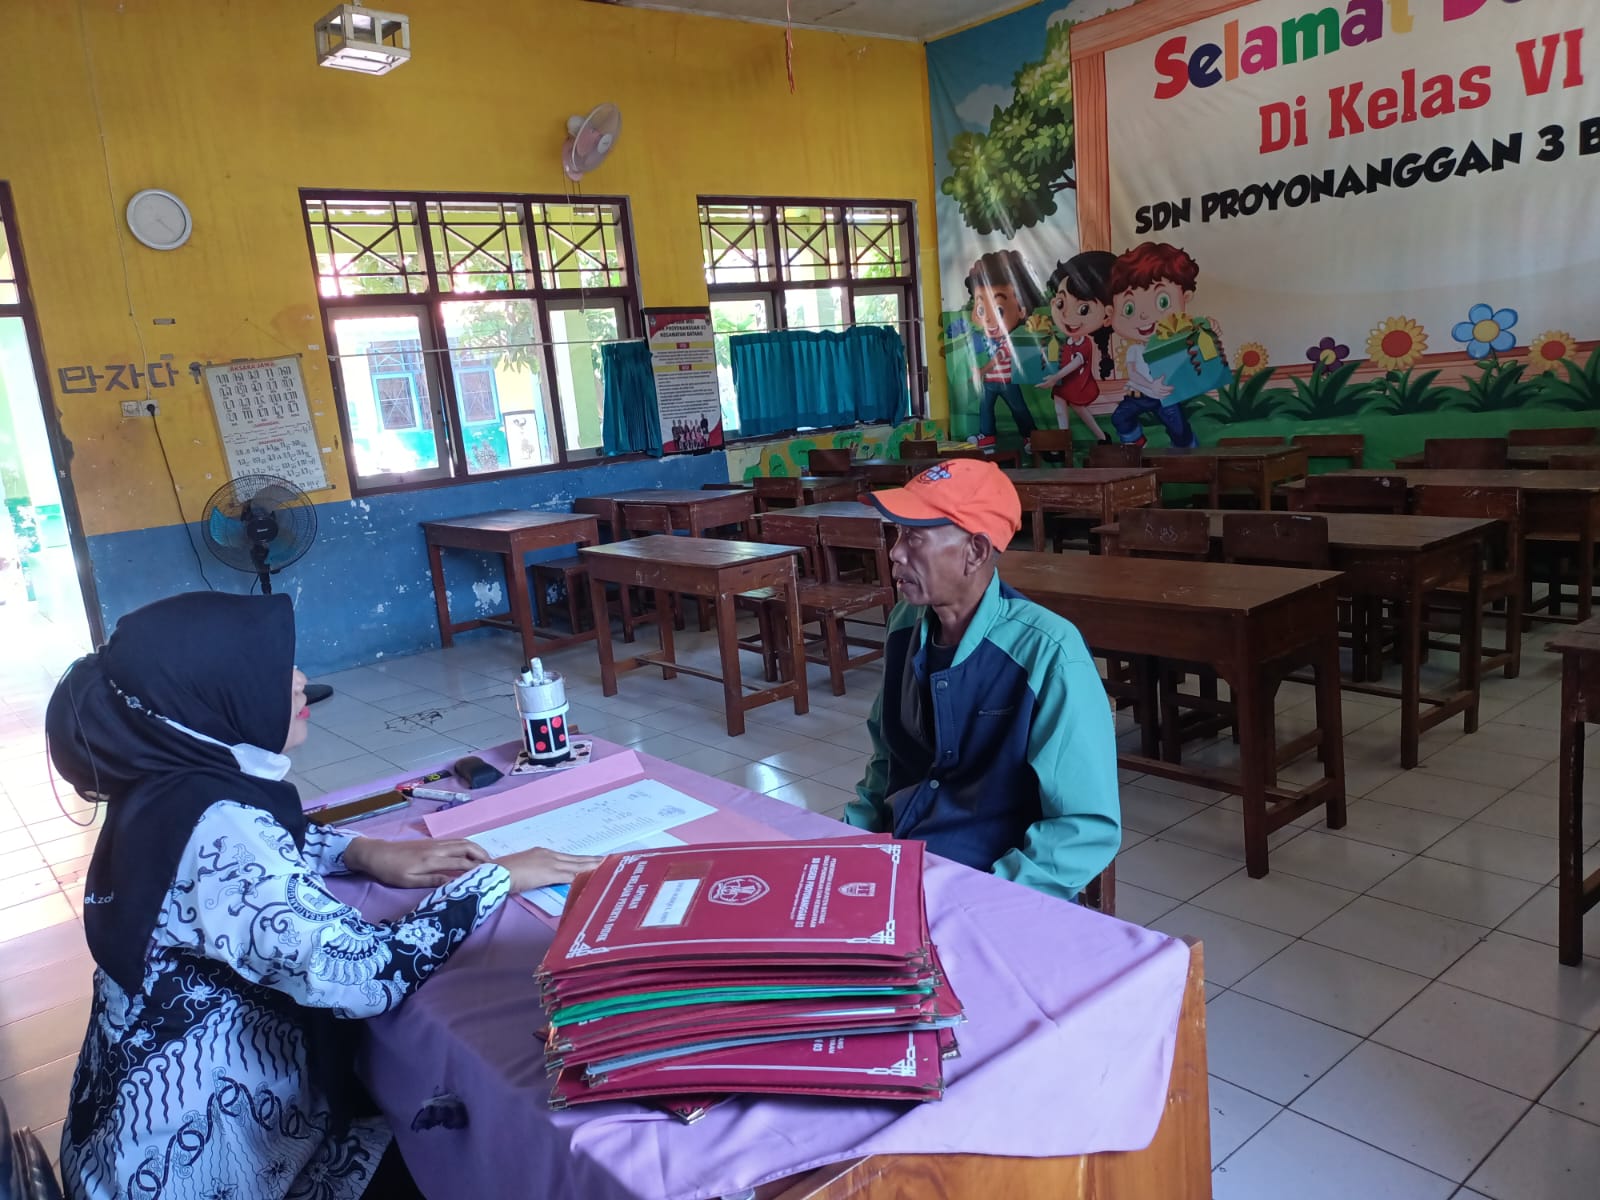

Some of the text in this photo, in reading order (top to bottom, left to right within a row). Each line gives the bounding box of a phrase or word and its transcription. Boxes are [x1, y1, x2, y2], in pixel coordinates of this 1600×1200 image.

[1153, 0, 1415, 100] Selamat
[1259, 28, 1584, 154] Di Kelas VI
[1135, 197, 1191, 234] SDN
[1201, 132, 1523, 222] PROYONANGGAN
[1536, 124, 1565, 162] 3
